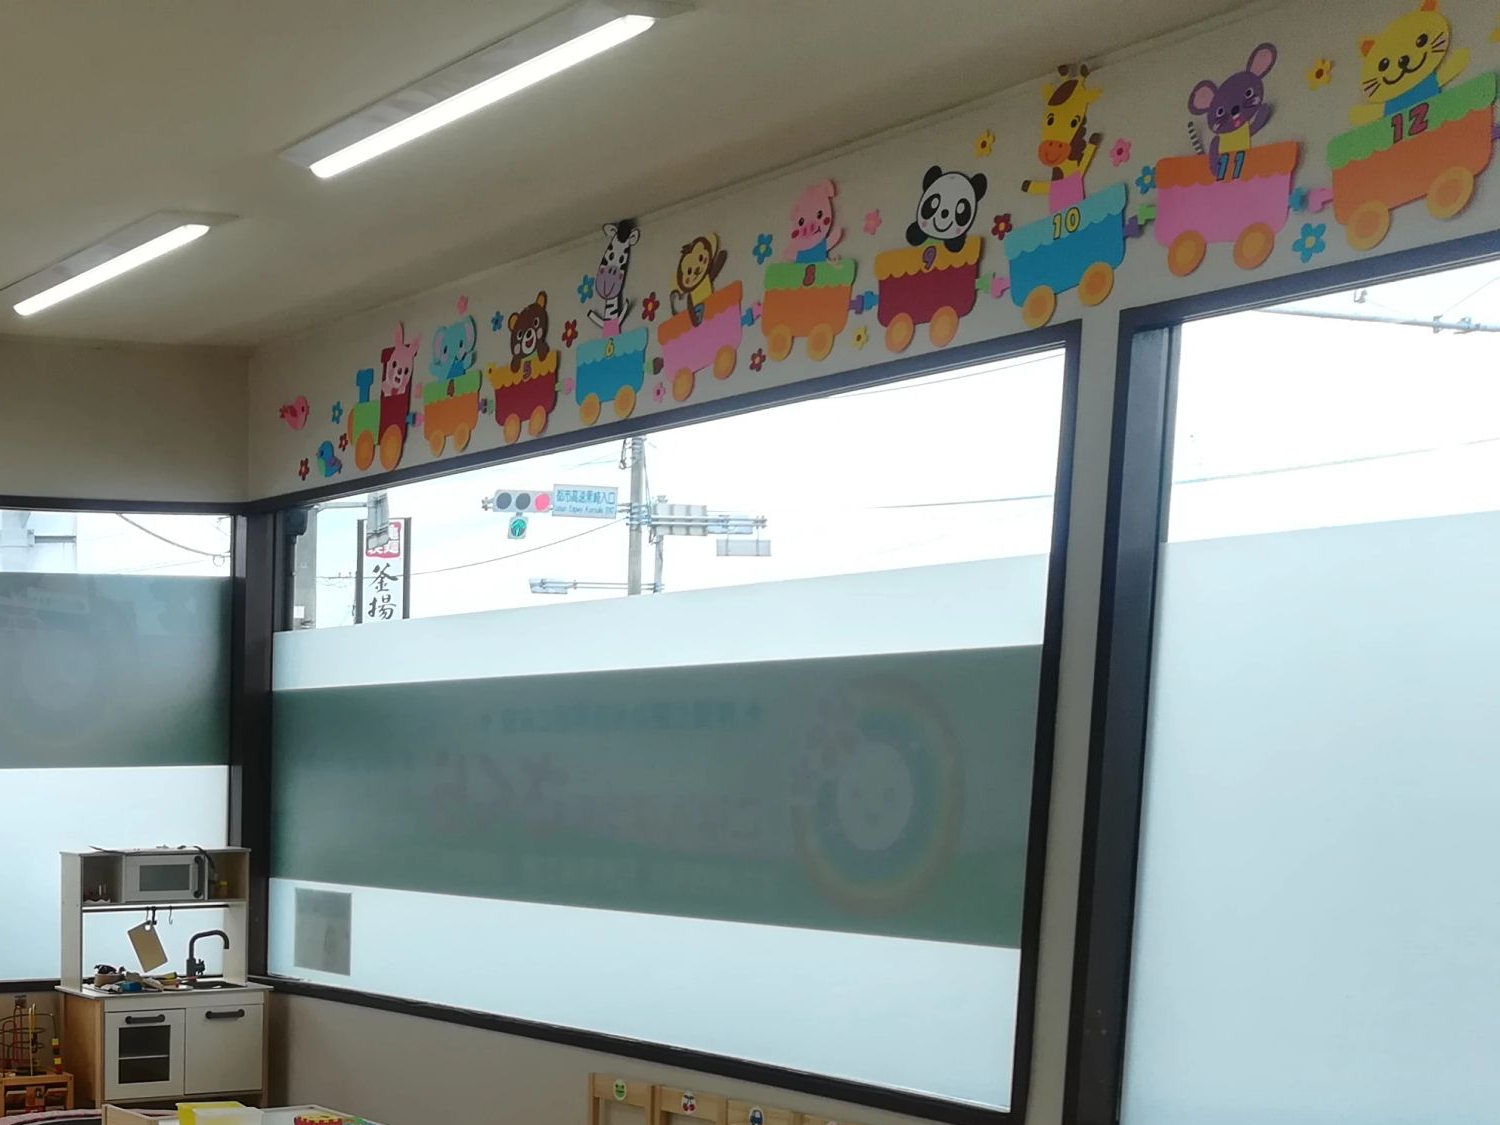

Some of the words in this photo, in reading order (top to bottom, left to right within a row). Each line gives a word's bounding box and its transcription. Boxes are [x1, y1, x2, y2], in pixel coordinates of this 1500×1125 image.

[1391, 102, 1429, 144] 12
[1216, 151, 1245, 181] 11
[1052, 207, 1081, 240] 10
[922, 246, 936, 270] 9
[803, 264, 816, 286] 8
[692, 303, 704, 327] 7
[605, 337, 614, 358] 6
[523, 361, 532, 380] 5
[368, 562, 399, 621] 釜揚
